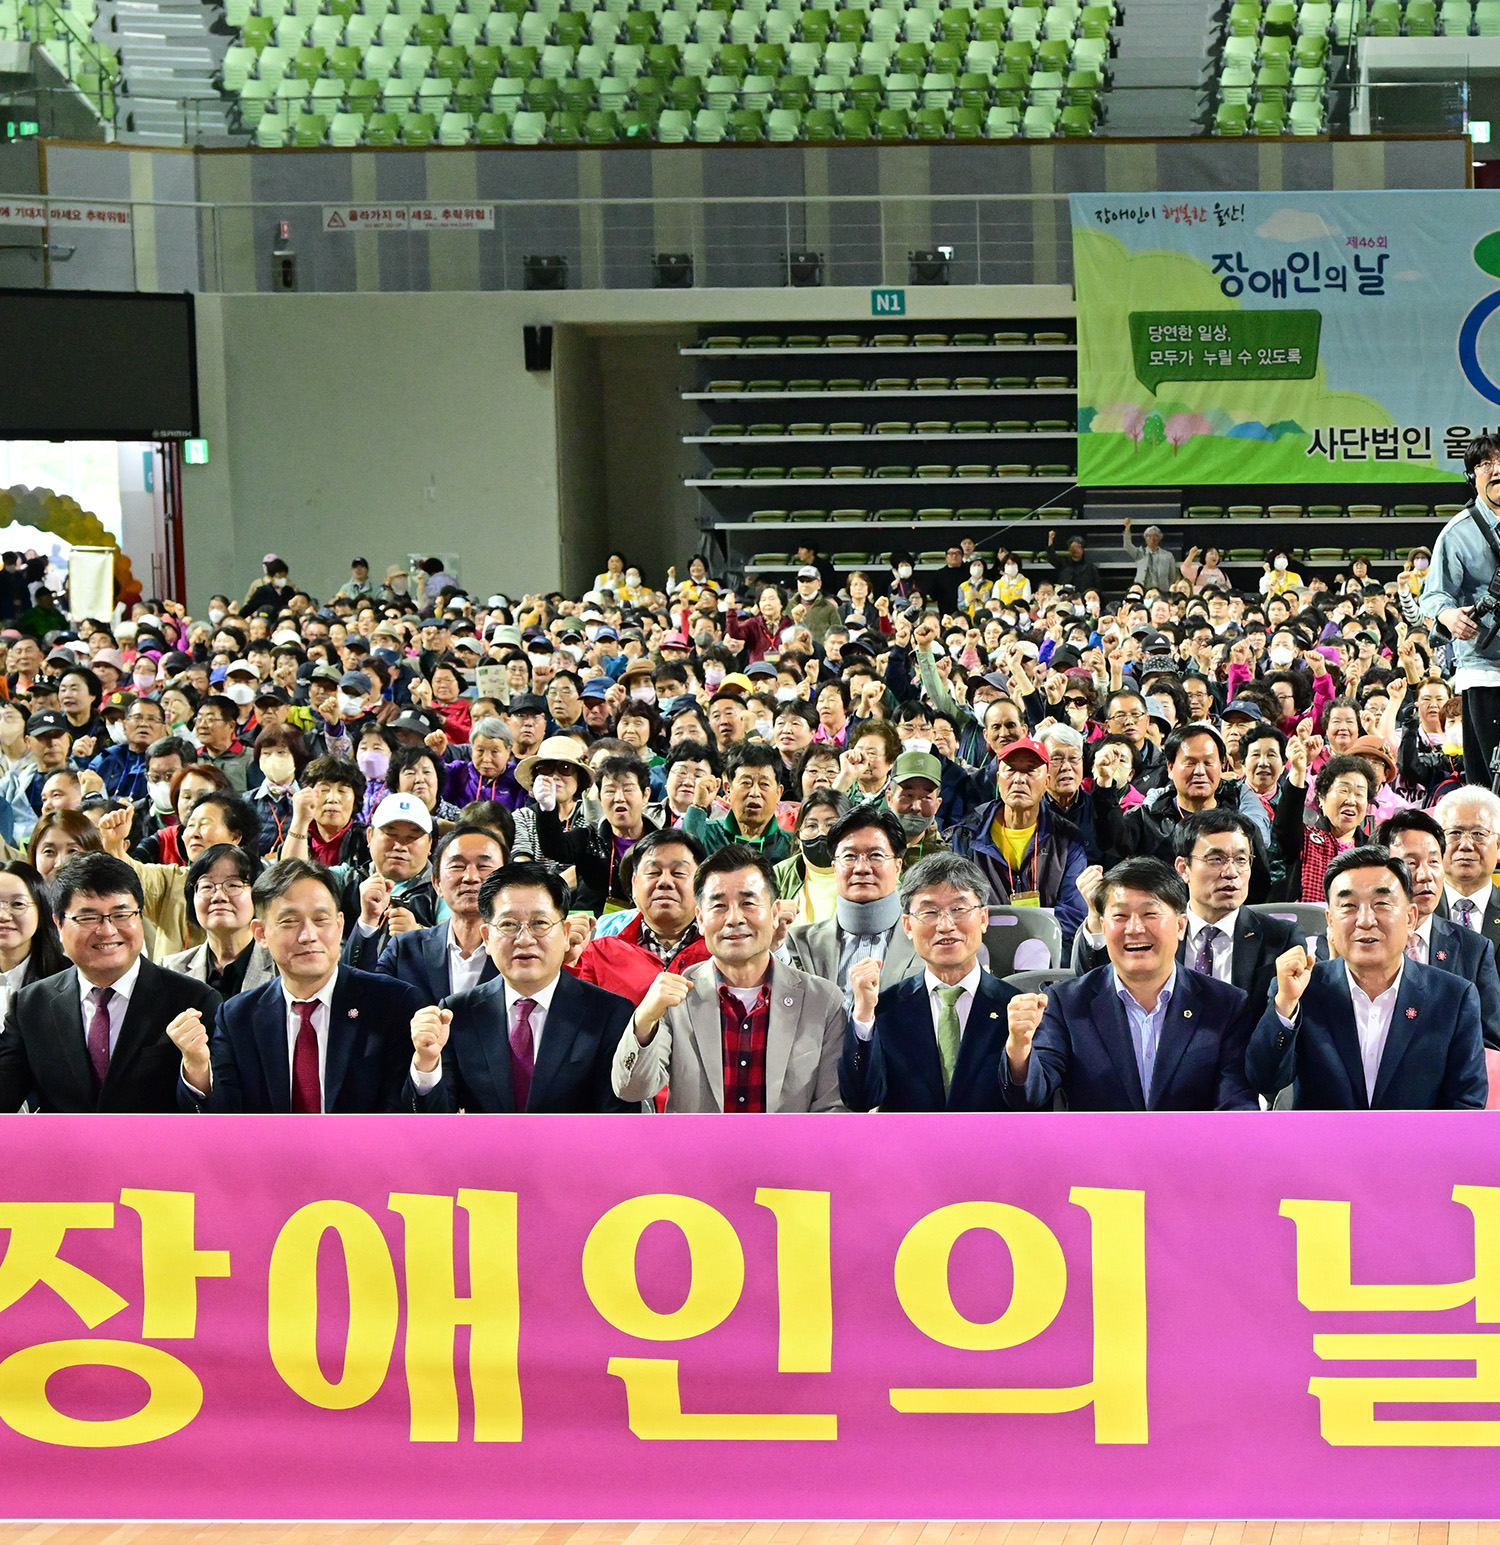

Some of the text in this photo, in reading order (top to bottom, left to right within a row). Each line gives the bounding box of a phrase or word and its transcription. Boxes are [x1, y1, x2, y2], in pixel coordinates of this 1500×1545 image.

[1095, 202, 1245, 227] 장애인이 행복한 울산!
[1345, 235, 1388, 249] 제46회
[1212, 251, 1390, 298] 장애인의 날
[877, 293, 901, 311] N1
[1149, 325, 1231, 342] 당연한 일상,
[1149, 348, 1302, 366] 모두가 누릴 수 있도록
[1306, 427, 1432, 460] 사단법인
[0, 1187, 1149, 1448] 장애인의
